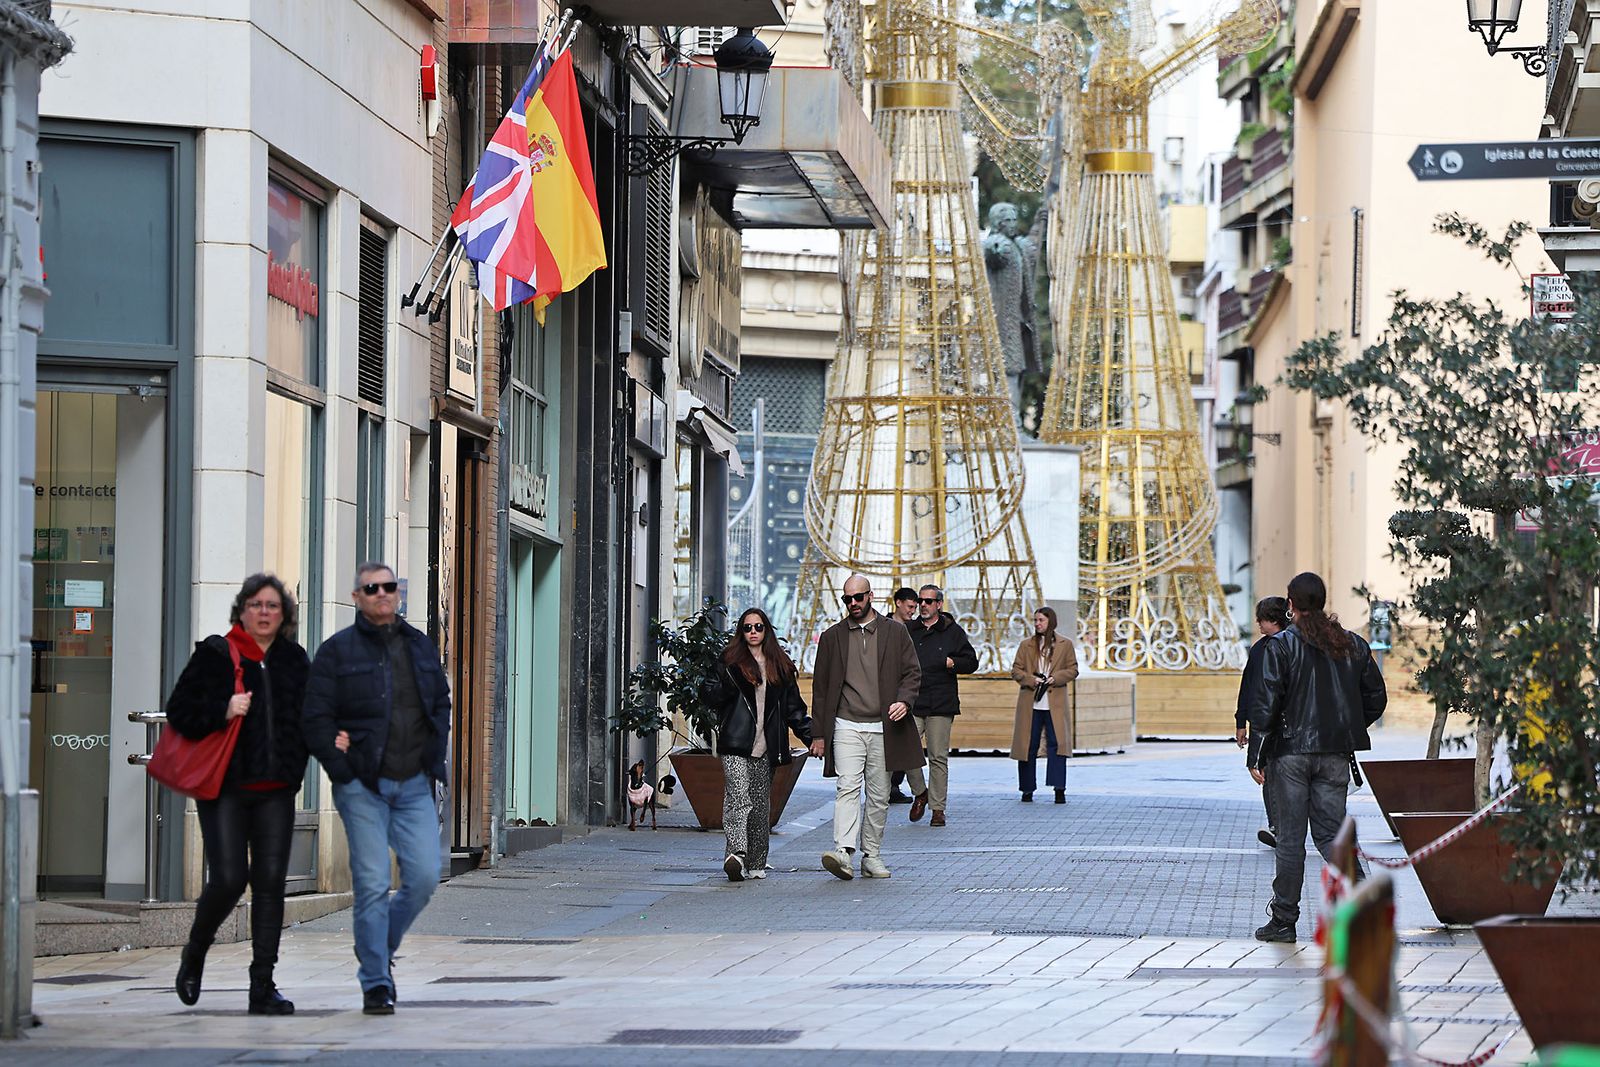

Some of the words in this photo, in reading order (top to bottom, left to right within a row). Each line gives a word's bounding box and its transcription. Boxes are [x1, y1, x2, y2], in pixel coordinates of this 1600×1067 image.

[1484, 147, 1525, 162] Iglesia
[1528, 147, 1545, 159] de
[1547, 146, 1559, 159] la
